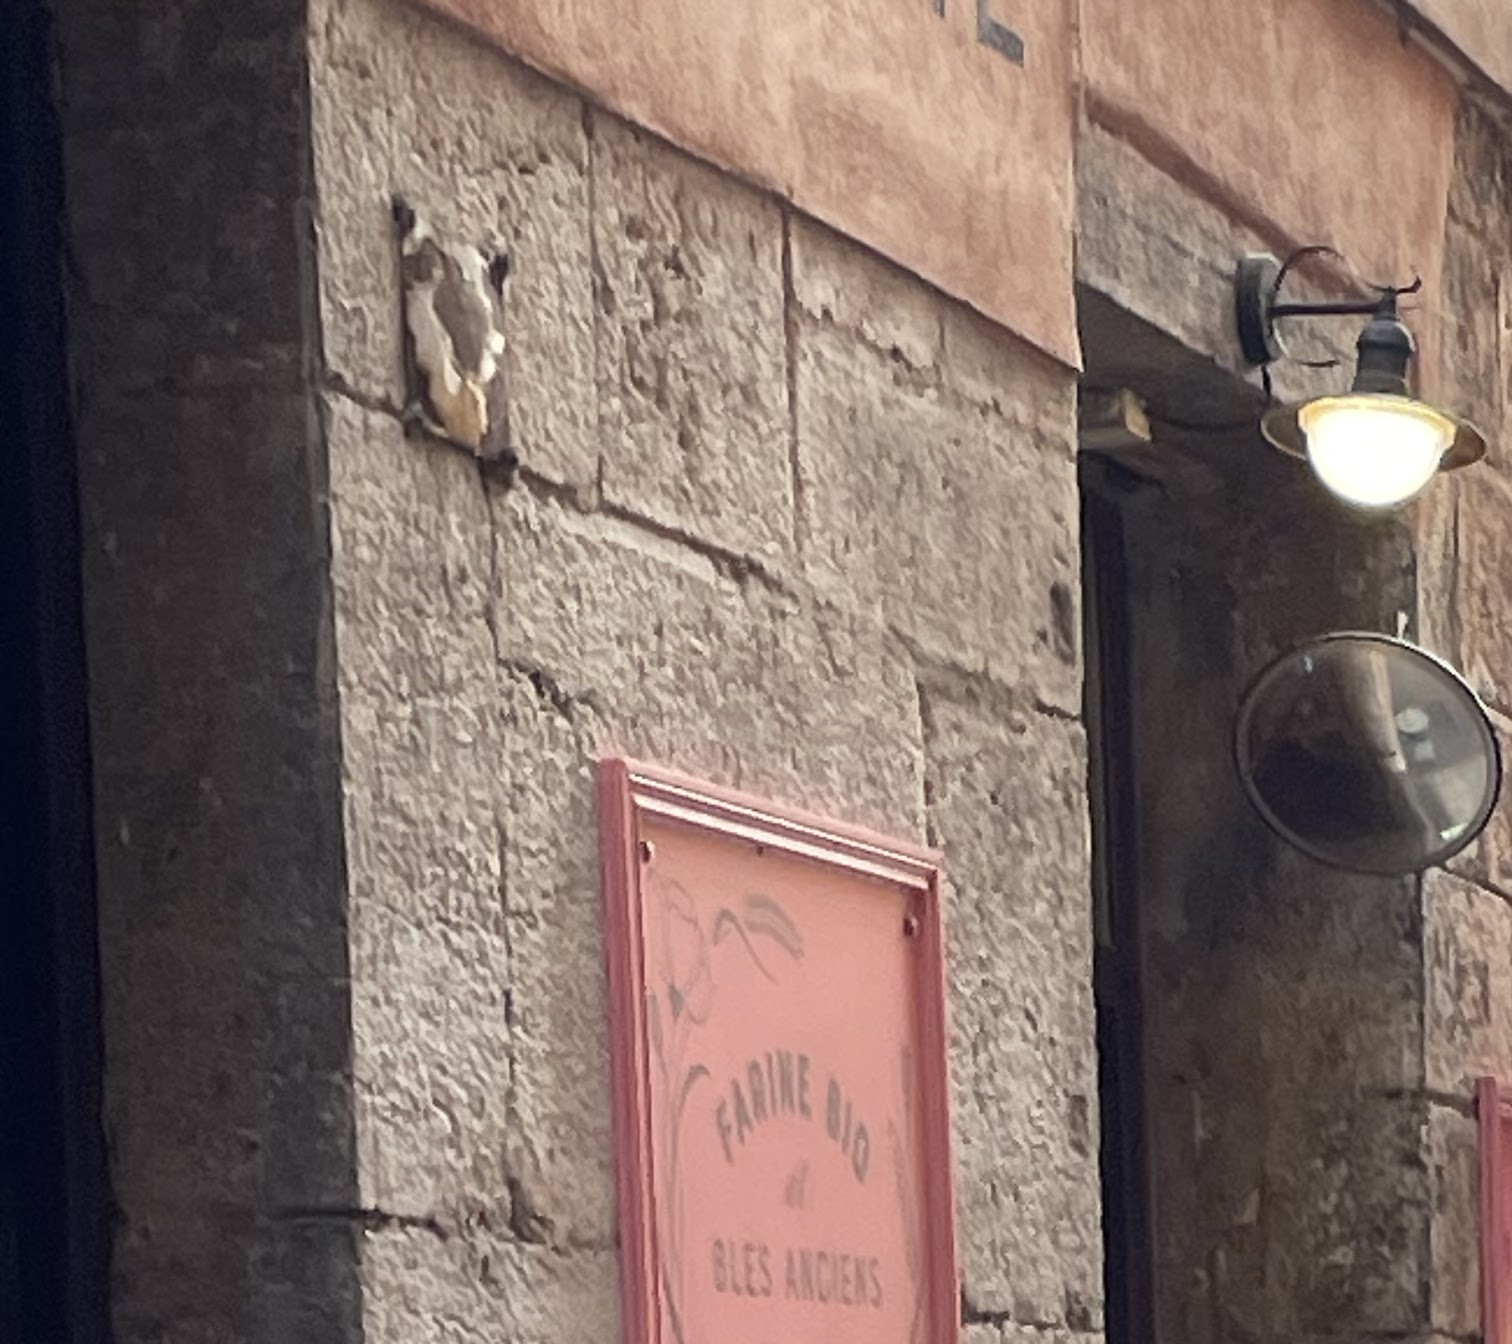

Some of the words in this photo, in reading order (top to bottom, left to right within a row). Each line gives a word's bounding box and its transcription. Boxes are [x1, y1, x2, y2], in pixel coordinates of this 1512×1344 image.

[715, 1047, 813, 1167] FARINE
[825, 1075, 870, 1186] BIO
[782, 1246, 884, 1309] ANCIENS
